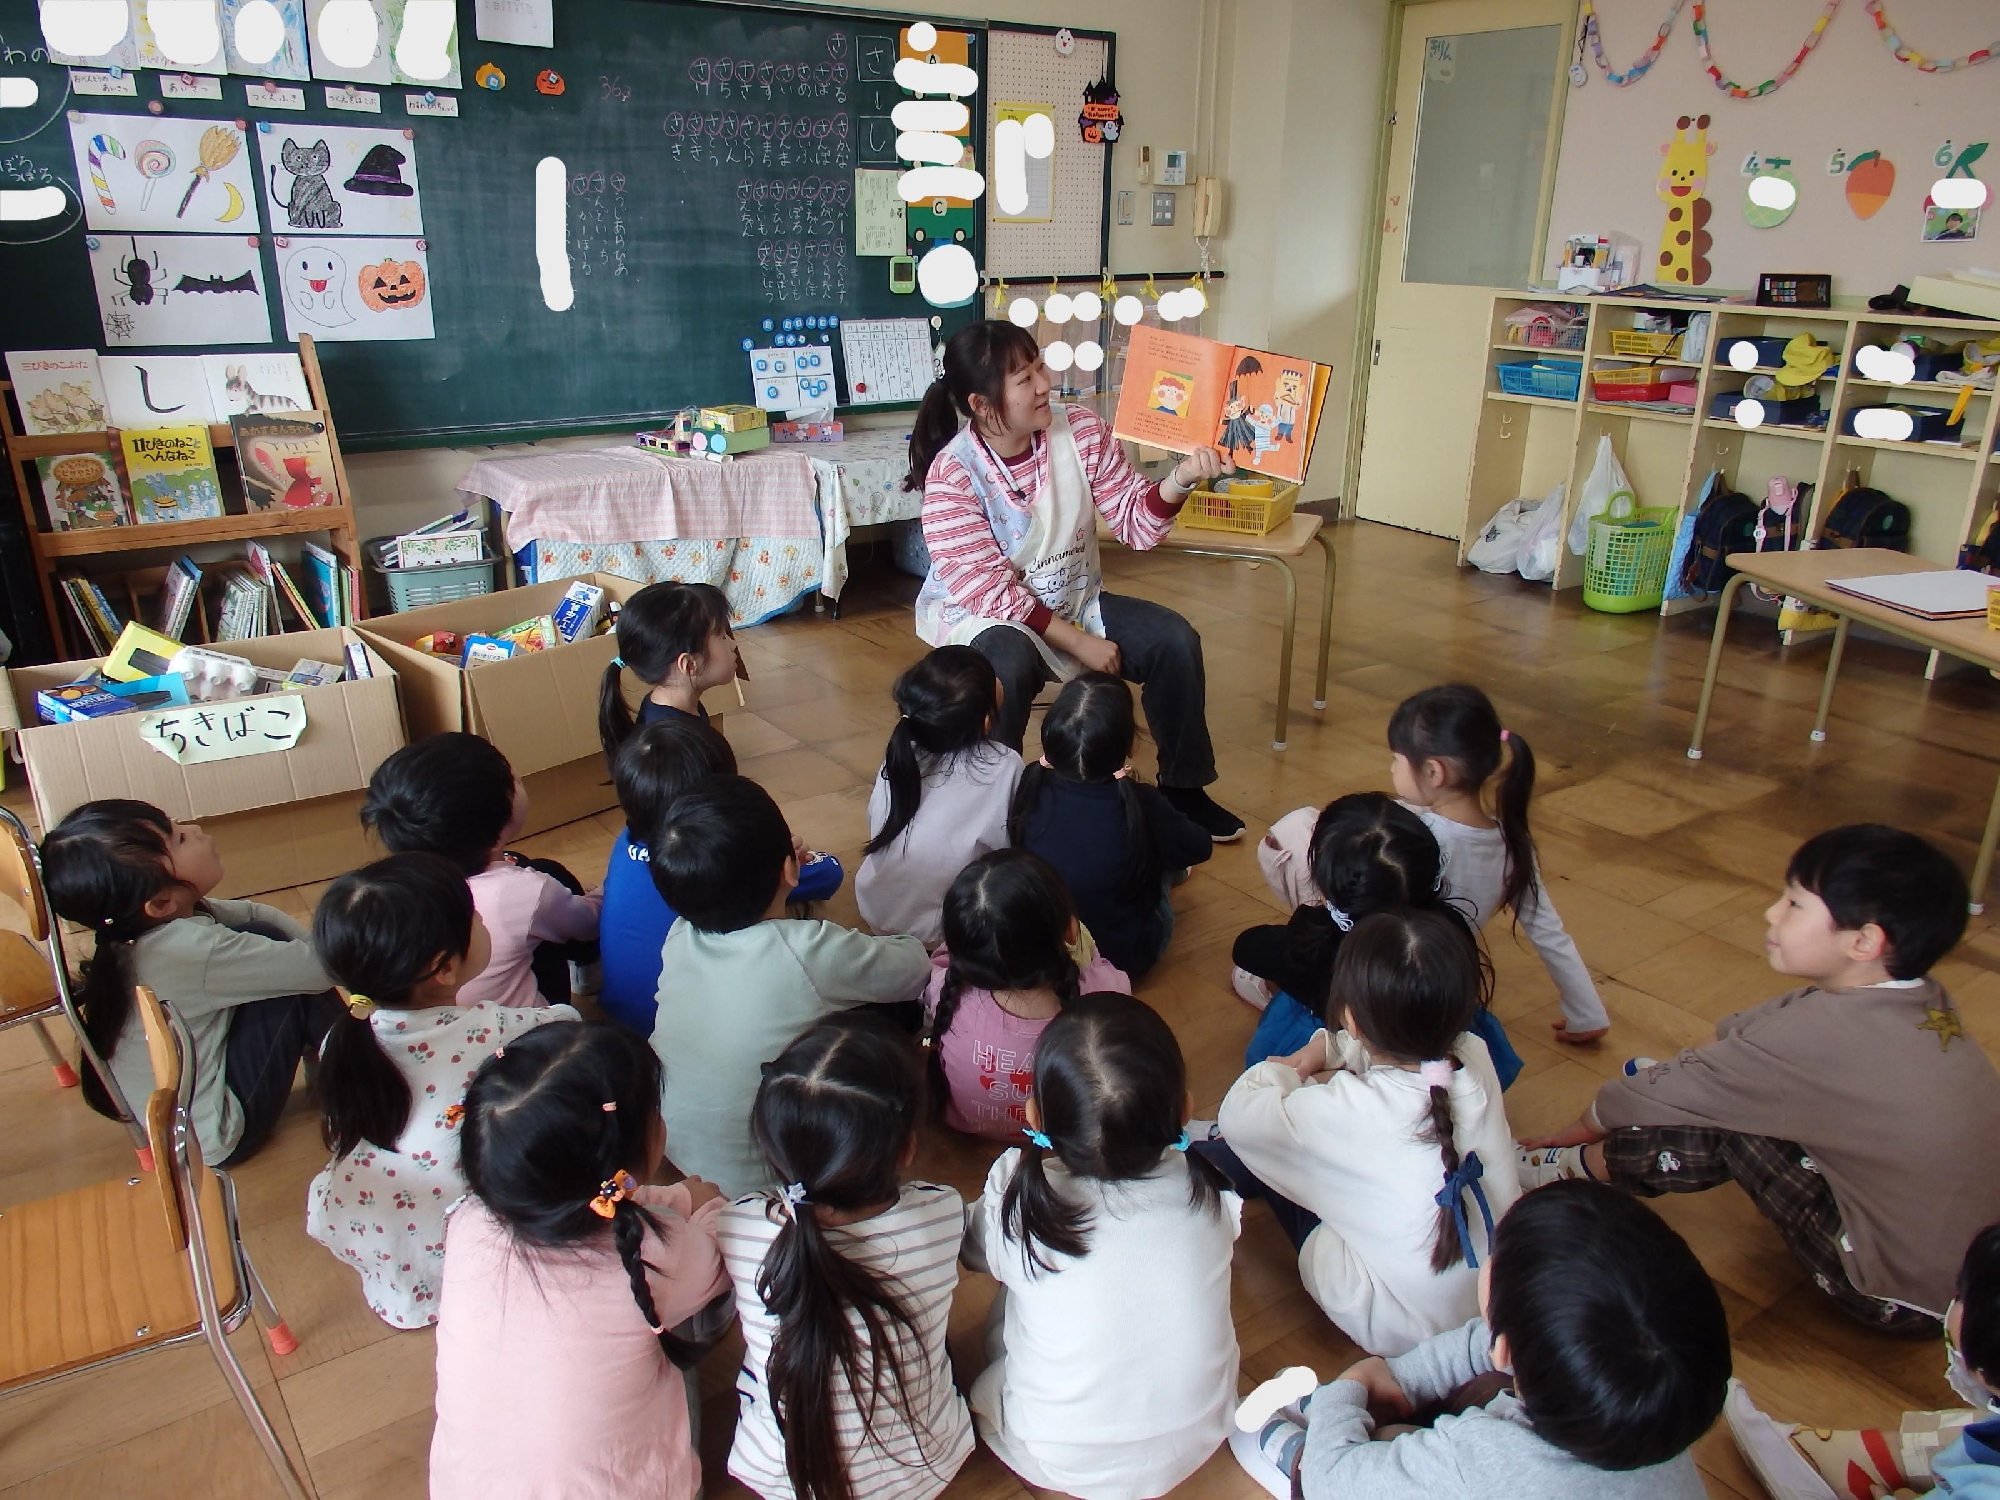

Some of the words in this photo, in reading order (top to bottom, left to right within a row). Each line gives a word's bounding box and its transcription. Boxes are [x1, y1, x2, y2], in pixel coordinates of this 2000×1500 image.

[866, 46, 884, 75] さ
[1829, 152, 1846, 174] 5
[1935, 144, 1952, 167] 6
[934, 201, 944, 214] C
